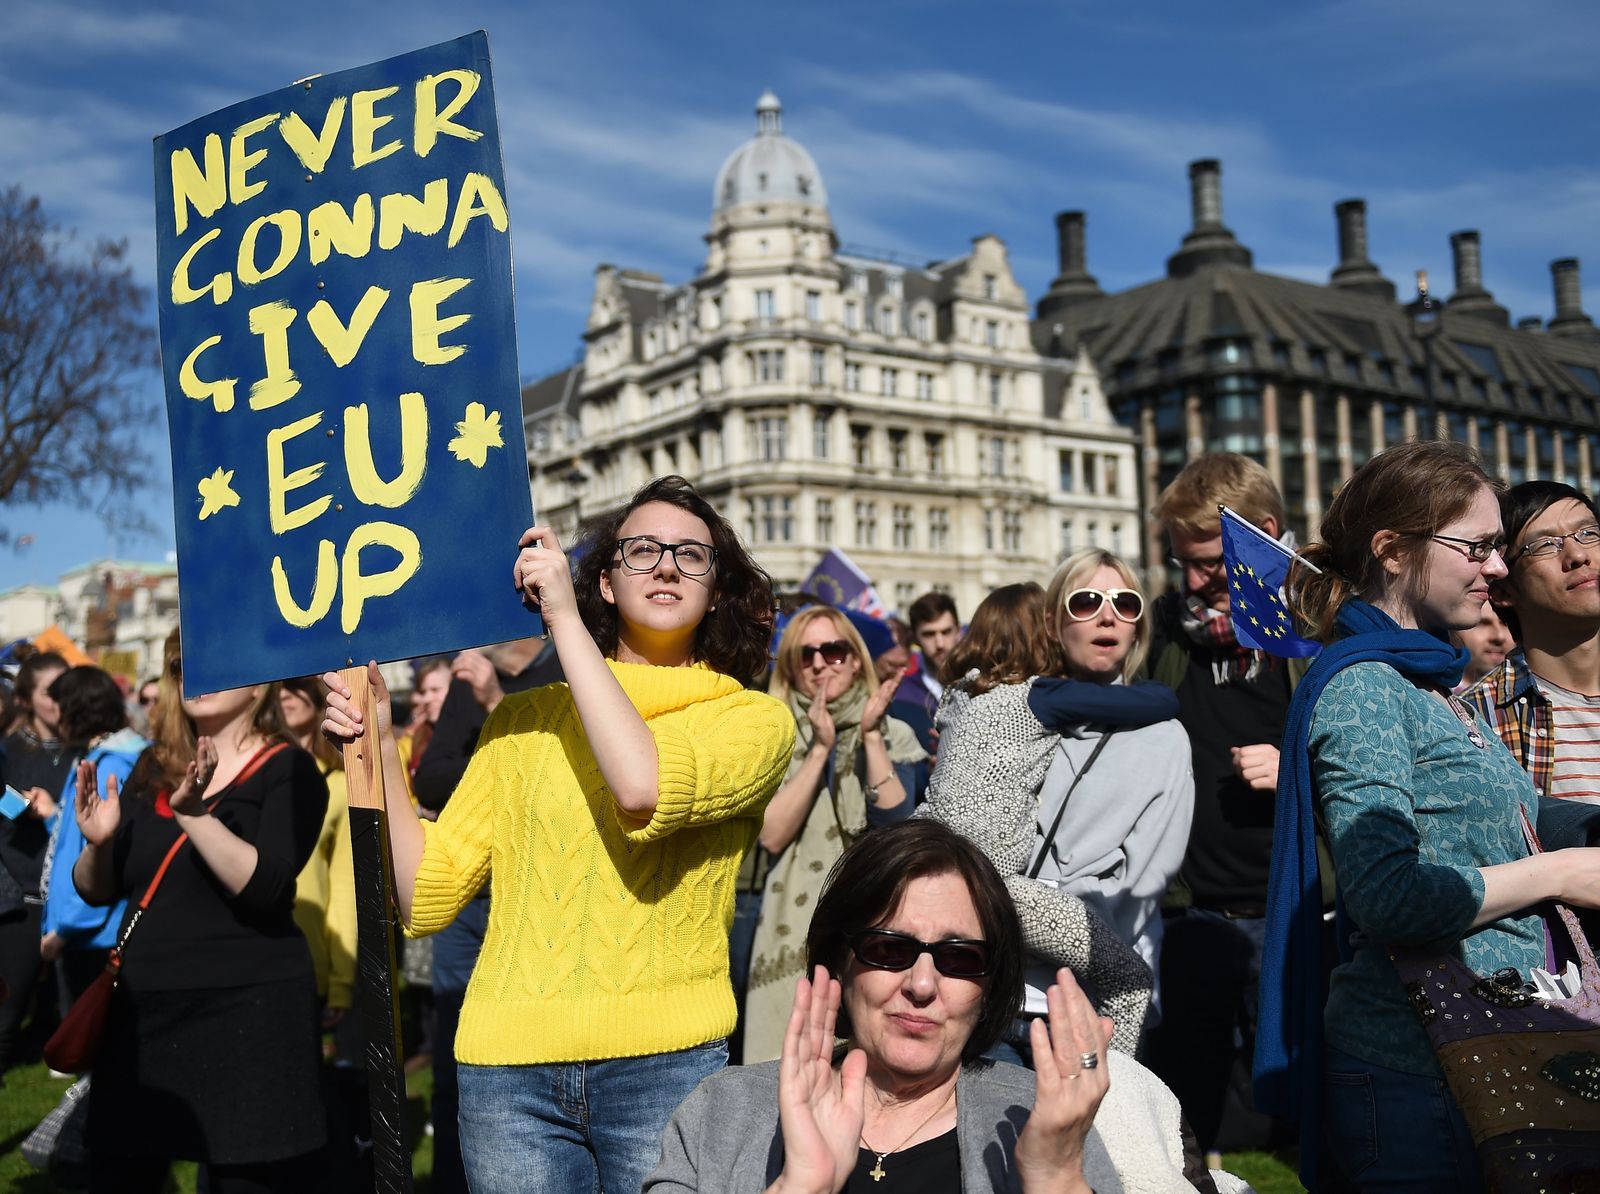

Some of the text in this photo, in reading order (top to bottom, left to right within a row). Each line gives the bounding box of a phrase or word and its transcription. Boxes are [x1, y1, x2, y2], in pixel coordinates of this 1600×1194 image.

[171, 69, 483, 235] NEVER
[171, 173, 509, 304] GONNA
[179, 278, 472, 412] GIVE
[267, 392, 429, 534] EU
[271, 521, 421, 634] UP
